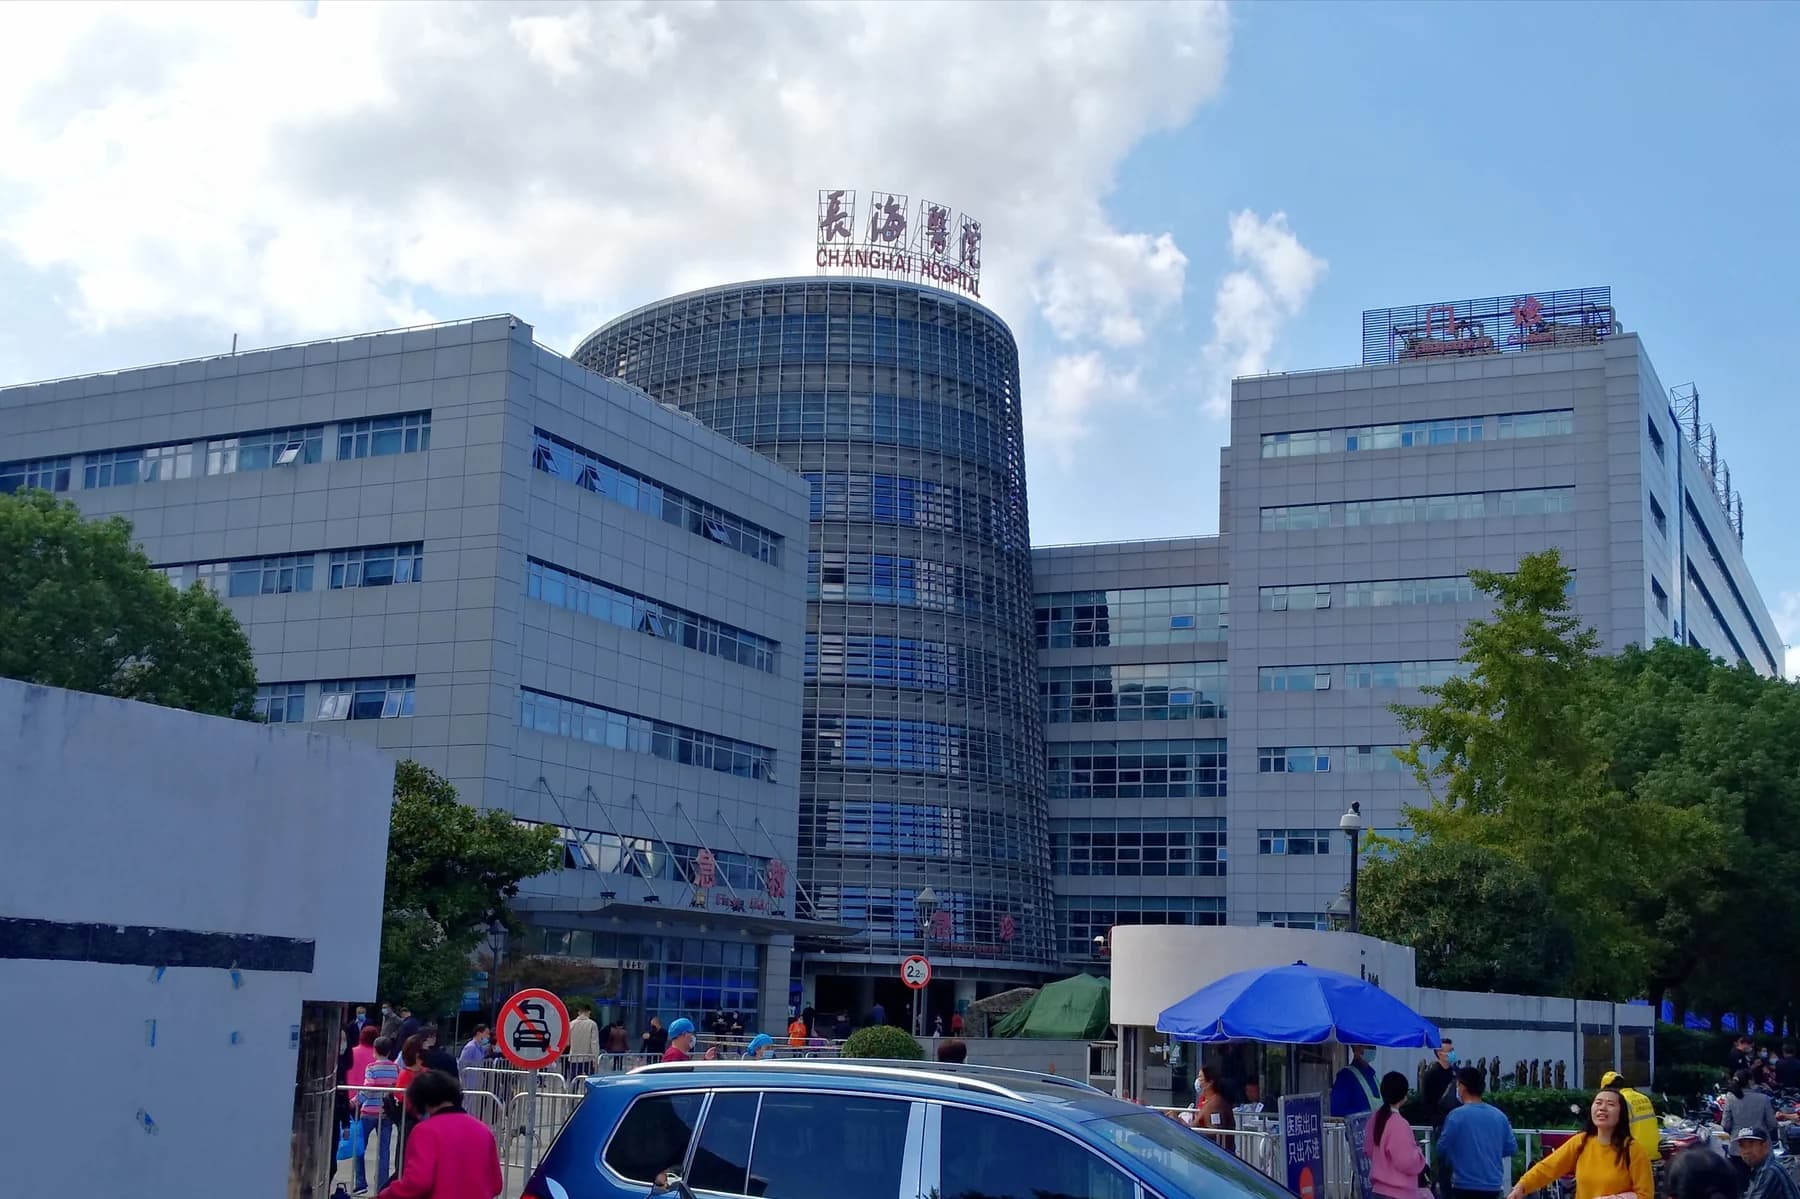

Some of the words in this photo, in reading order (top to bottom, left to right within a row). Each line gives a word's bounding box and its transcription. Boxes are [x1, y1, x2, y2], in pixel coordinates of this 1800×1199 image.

[816, 247, 912, 274] CHANGHAI
[920, 257, 981, 299] HOSPITAL
[694, 849, 786, 898] 急救
[1286, 1113, 1318, 1137] 医院出口
